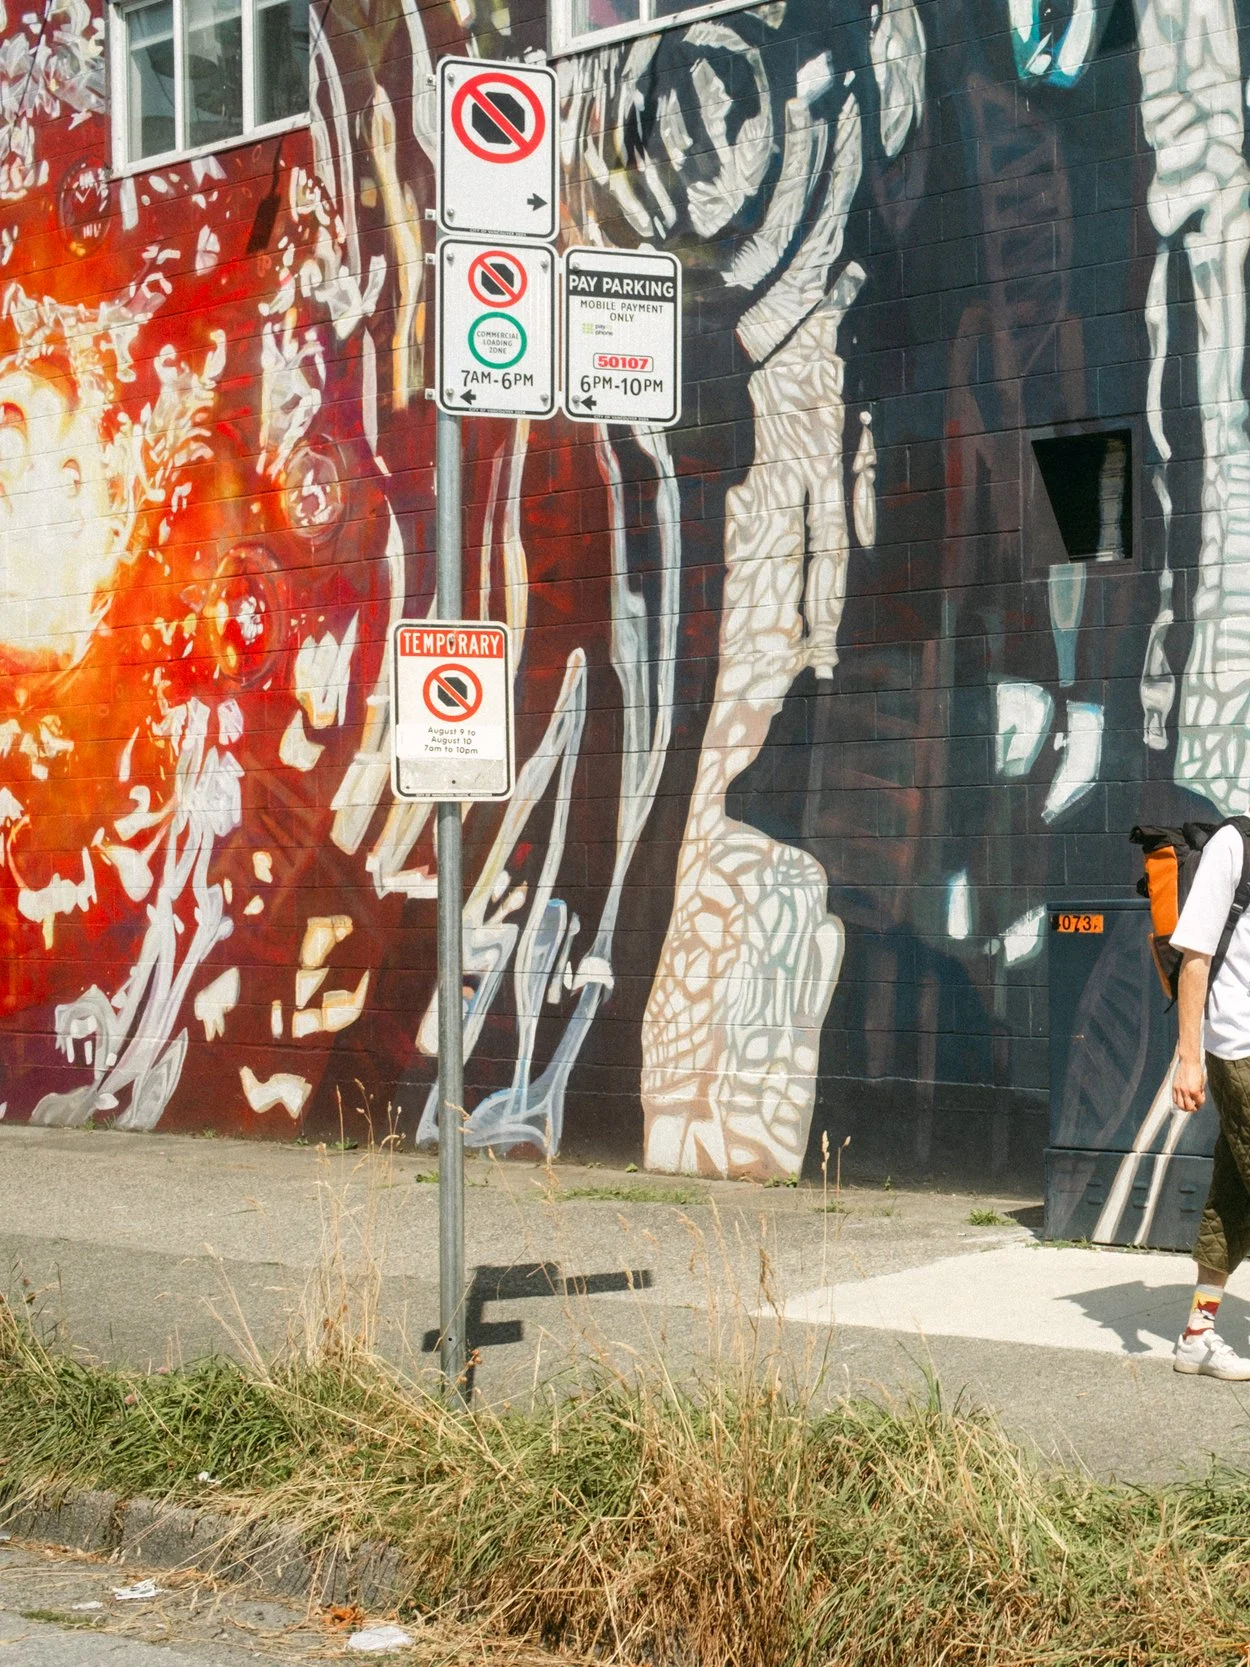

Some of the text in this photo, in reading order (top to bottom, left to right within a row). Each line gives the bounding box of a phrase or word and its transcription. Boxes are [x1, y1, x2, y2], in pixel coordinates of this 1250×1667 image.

[569, 275, 675, 298] PAY PARKING
[580, 300, 664, 314] MOBILE PAYMENT
[609, 312, 635, 323] ONLY
[476, 331, 520, 341] COMMERCIAL
[483, 338, 513, 347] LOADING
[488, 346, 507, 354] ZONE
[597, 355, 649, 370] 50107
[461, 369, 534, 390] 7AM-6PM
[580, 374, 663, 396] 6PM-10PM
[403, 632, 500, 656] TEMPORARY
[427, 726, 457, 736] August
[431, 736, 460, 745] August
[424, 744, 442, 752] 7am
[456, 746, 479, 755] 10pm
